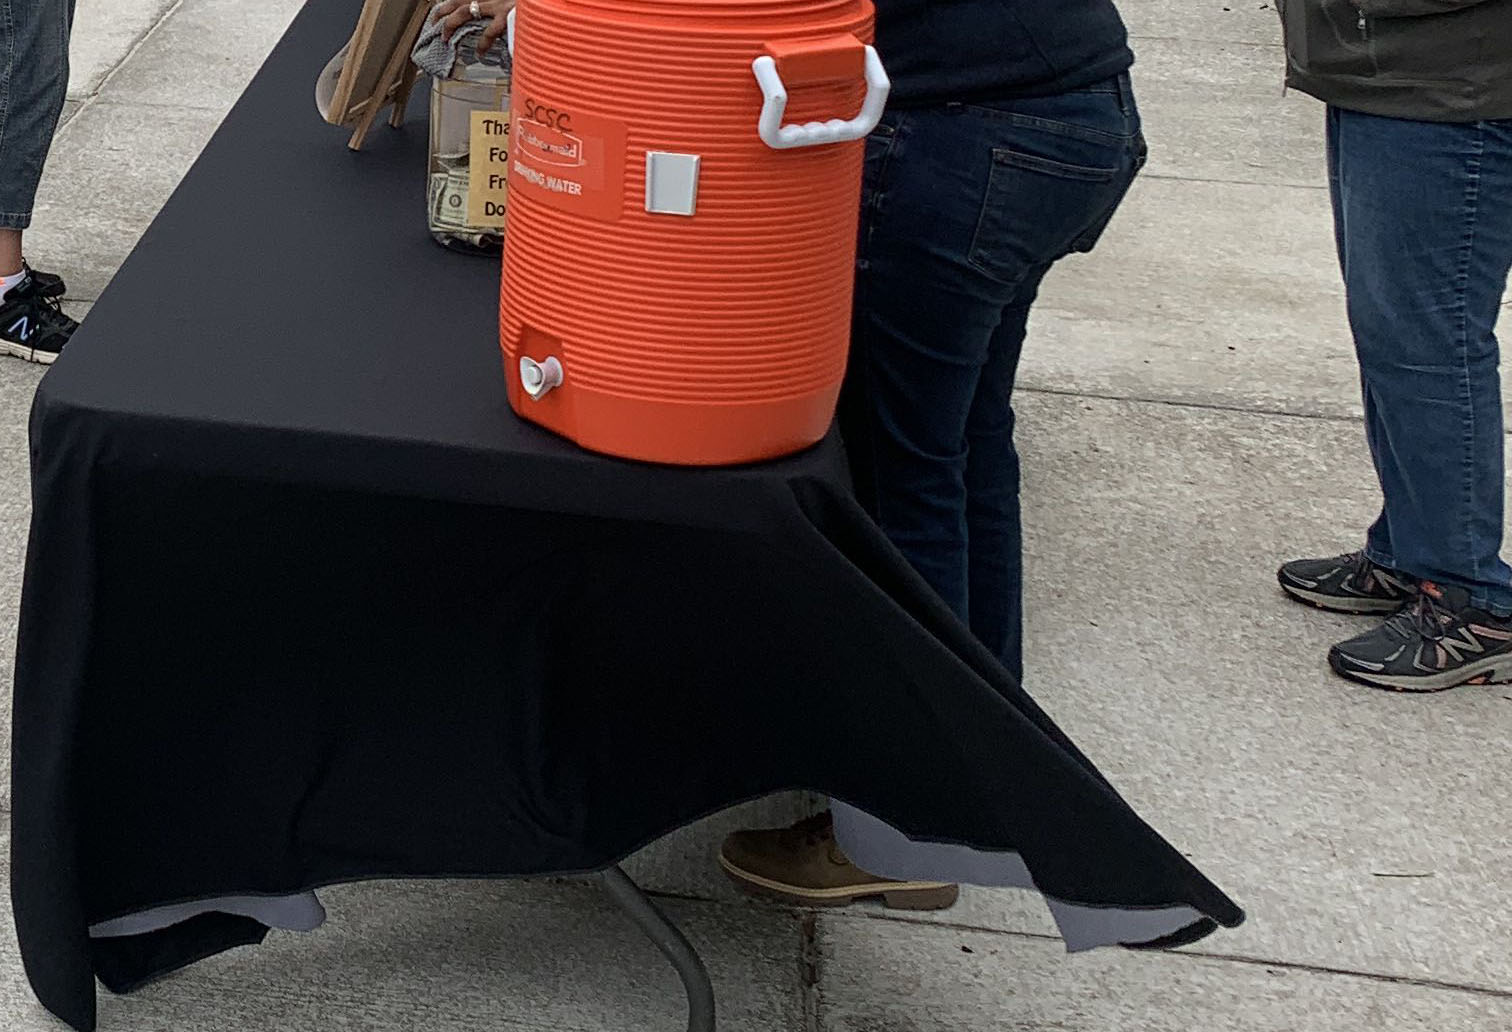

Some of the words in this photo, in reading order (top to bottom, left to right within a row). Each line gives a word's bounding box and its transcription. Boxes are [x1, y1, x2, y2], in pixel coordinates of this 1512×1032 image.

[524, 98, 573, 133] SCSC
[482, 119, 510, 136] Tha
[489, 147, 508, 162] Fo
[489, 174, 506, 190] Fr
[545, 175, 583, 196] WATER
[484, 201, 505, 216] Do
